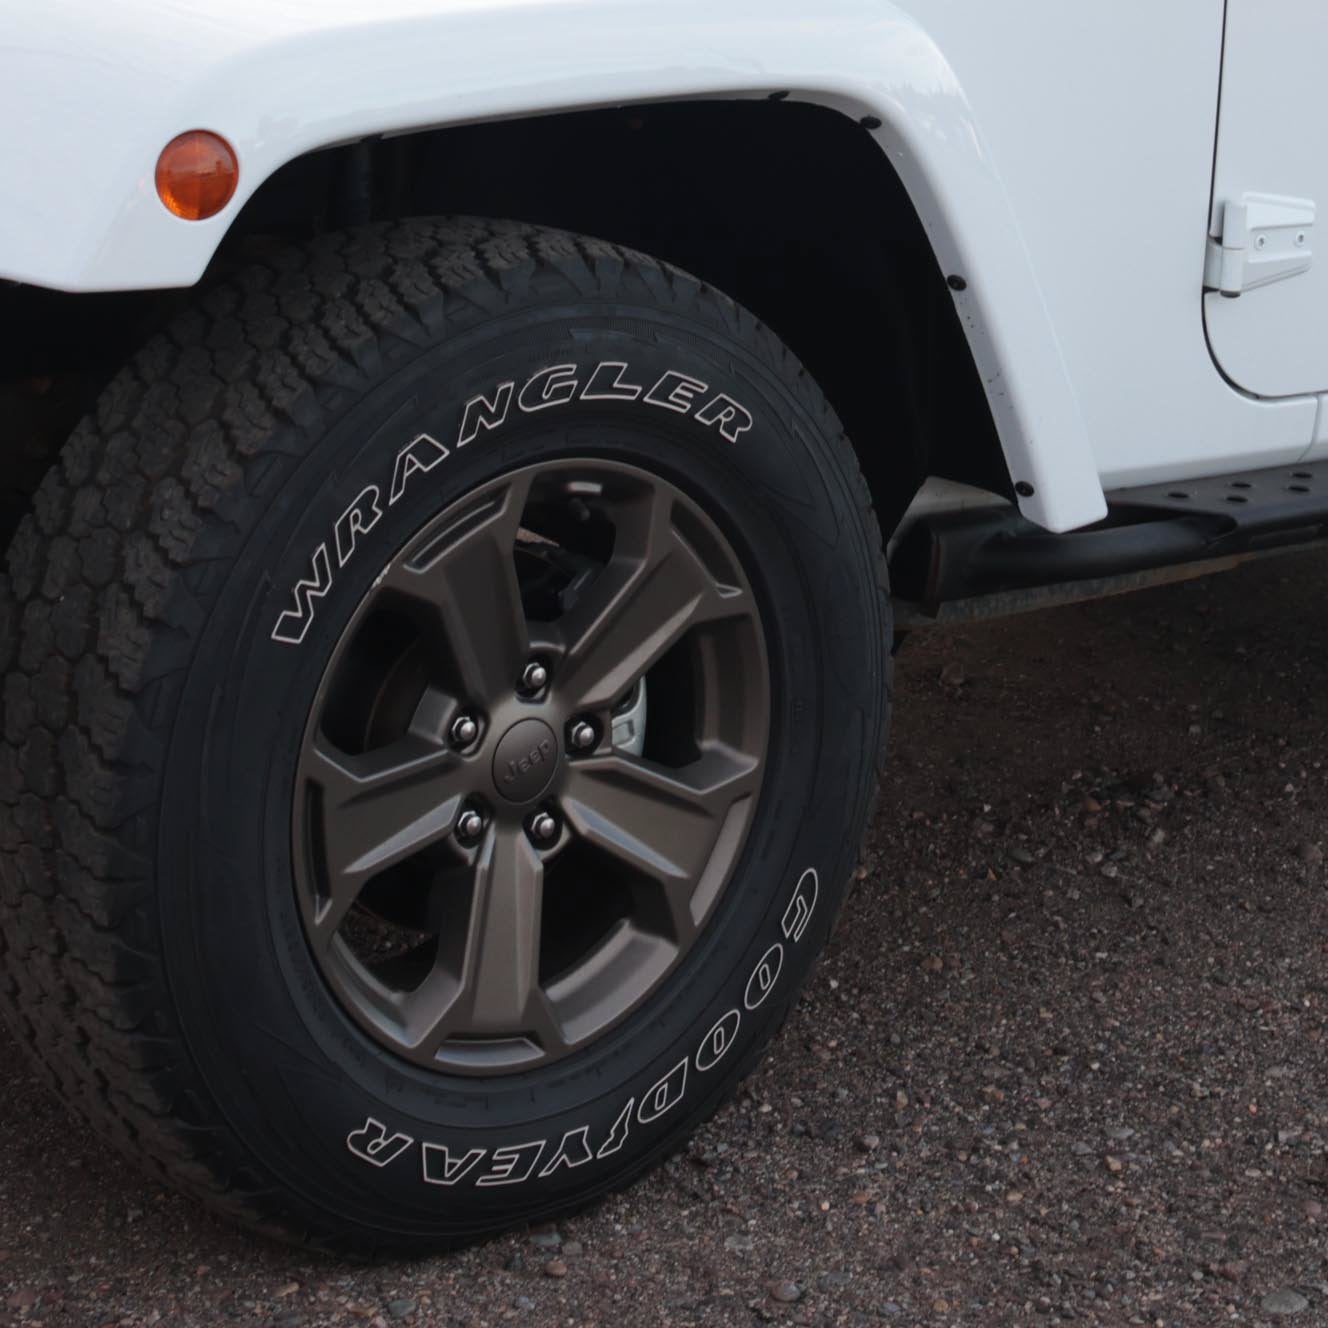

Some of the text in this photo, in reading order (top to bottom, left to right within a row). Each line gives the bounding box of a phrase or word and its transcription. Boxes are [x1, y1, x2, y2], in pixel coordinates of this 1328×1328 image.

[271, 360, 754, 645] WRANGLER
[503, 738, 550, 784] Jeep
[346, 866, 819, 1187] GOODYEAR
